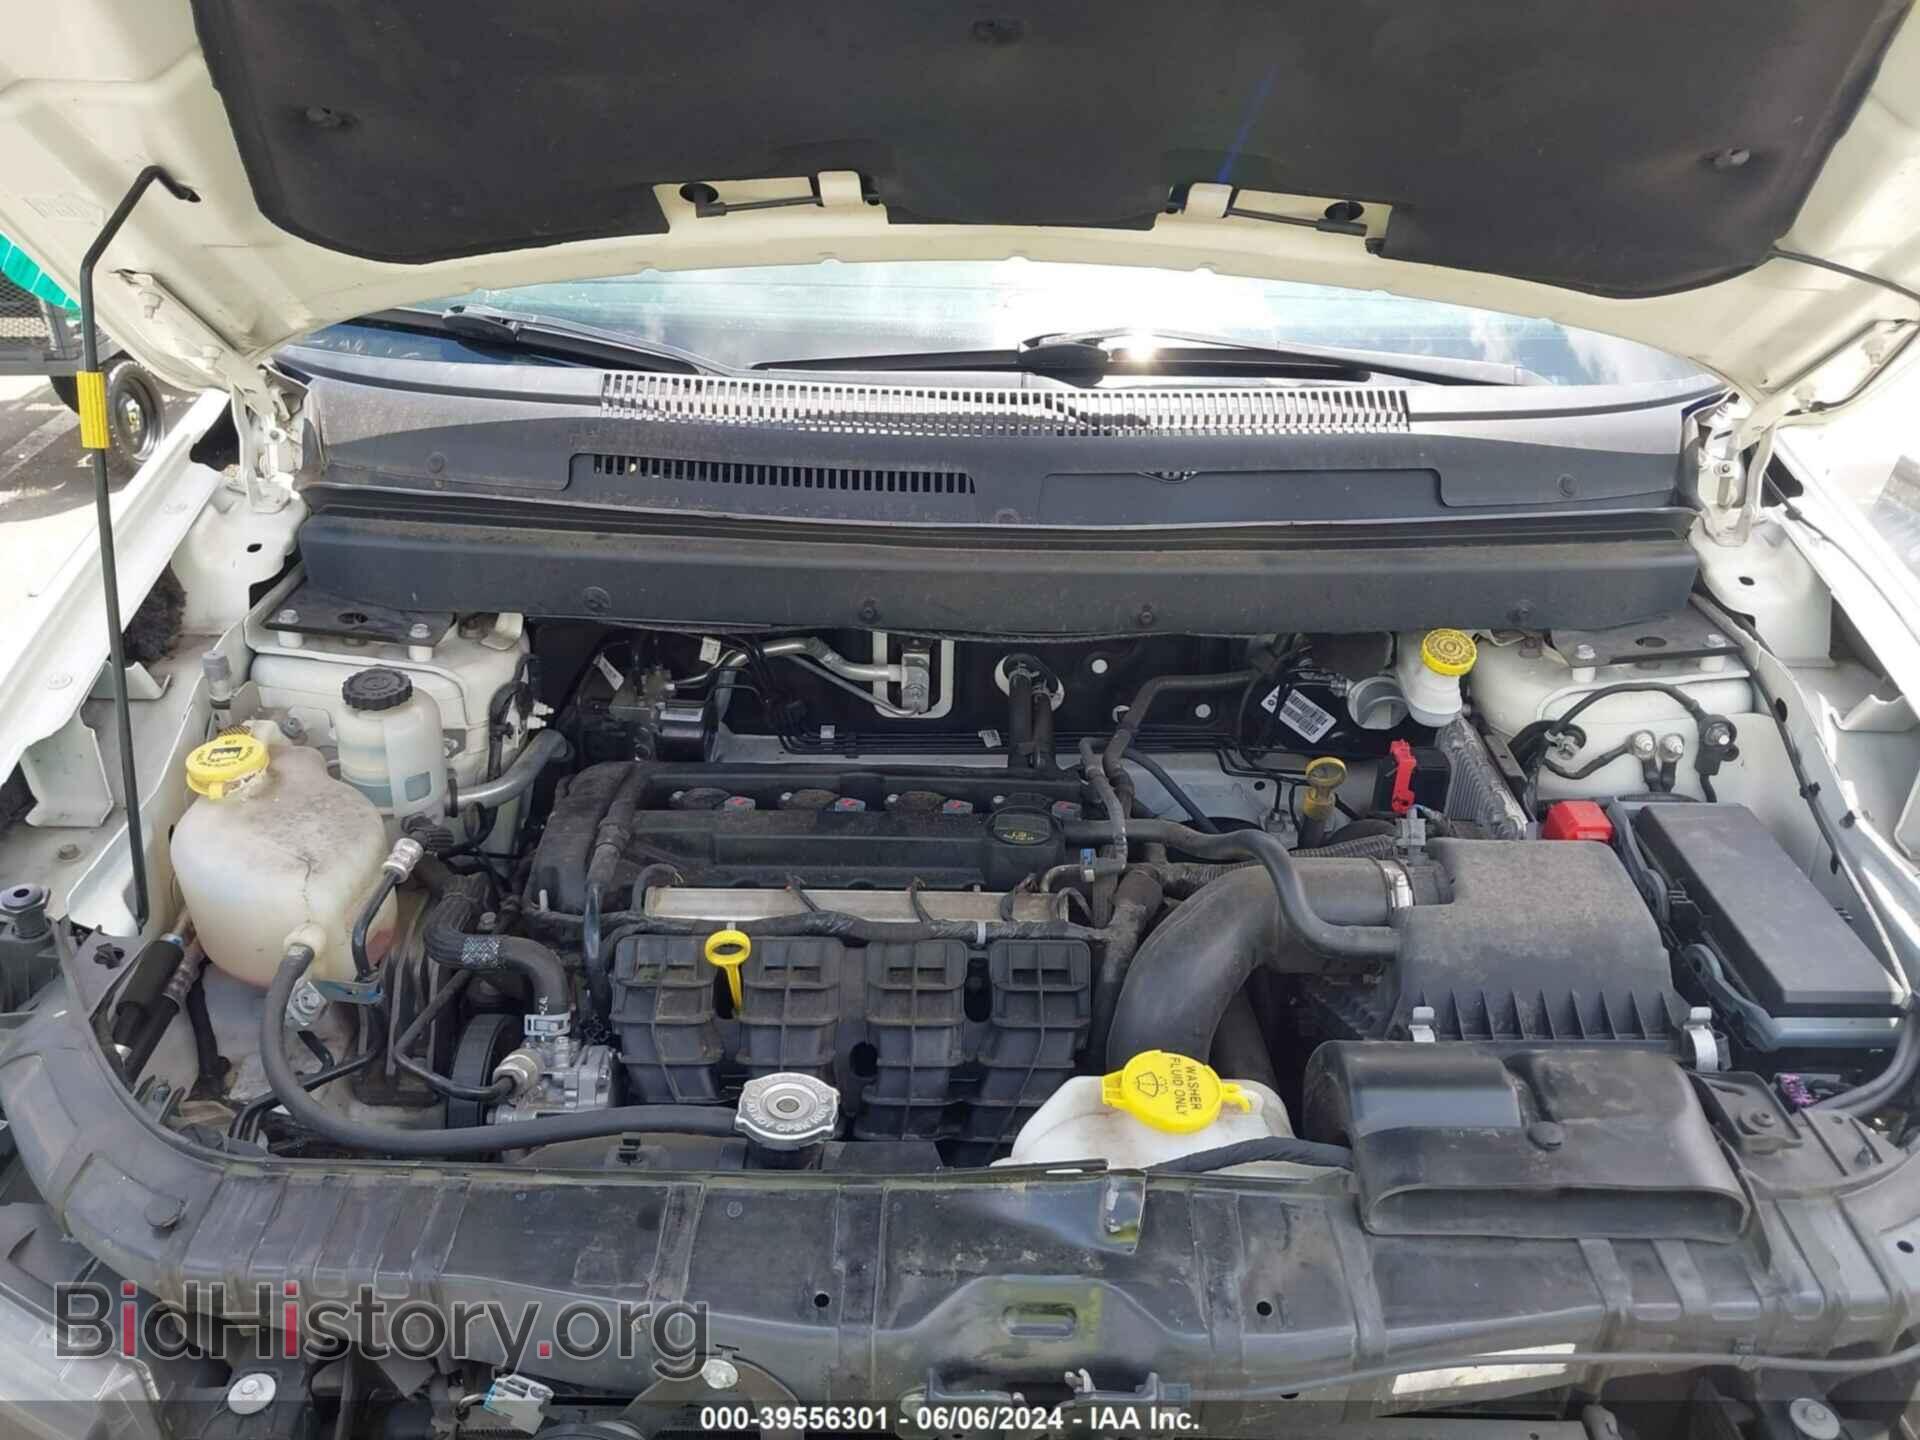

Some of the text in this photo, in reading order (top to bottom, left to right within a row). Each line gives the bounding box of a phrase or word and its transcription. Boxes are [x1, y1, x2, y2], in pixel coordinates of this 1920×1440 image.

[1169, 1056, 1188, 1115] FLUID ONLY
[1185, 1065, 1202, 1110] WASHER
